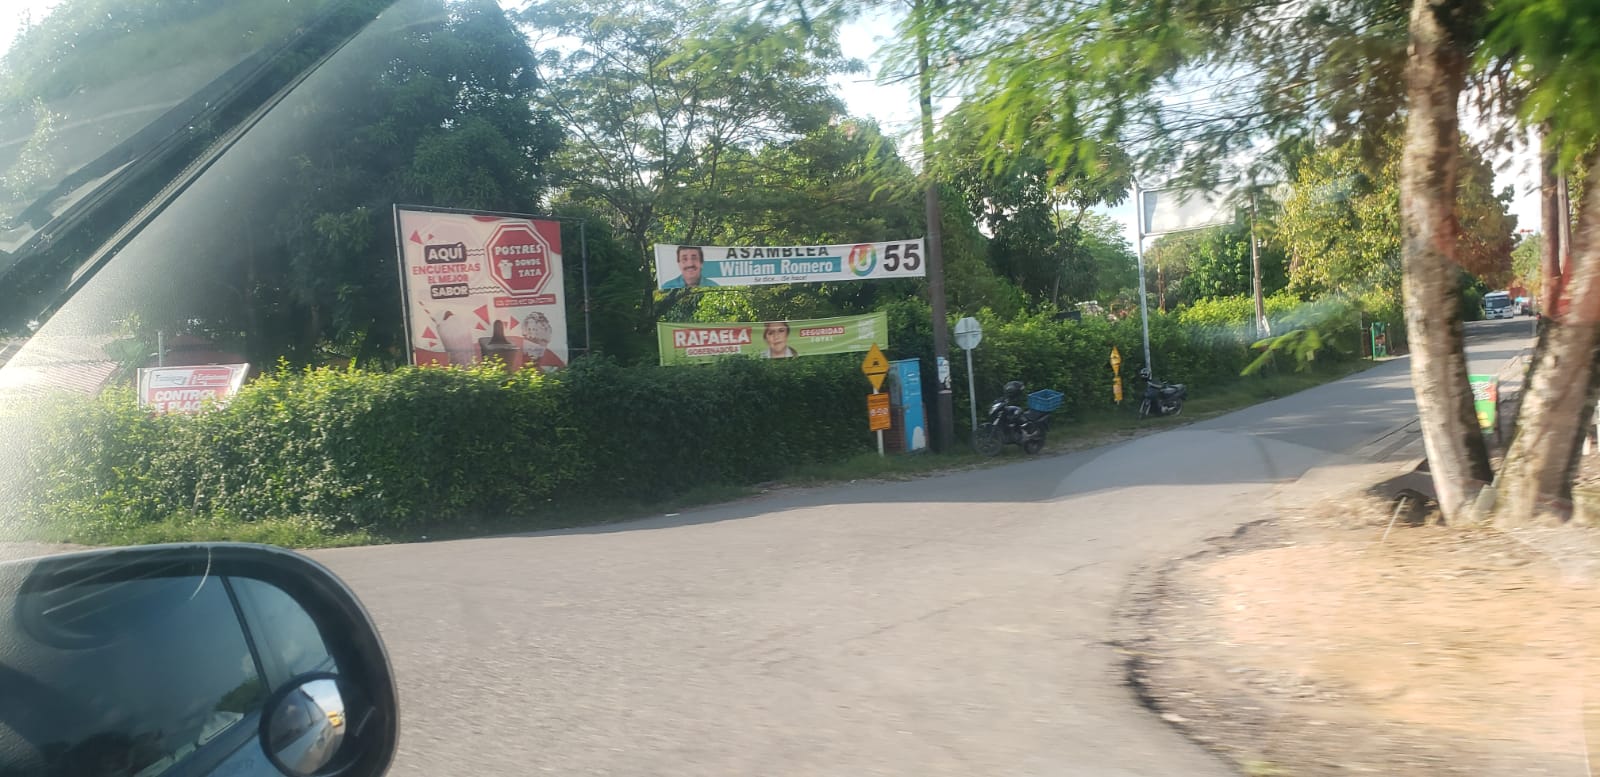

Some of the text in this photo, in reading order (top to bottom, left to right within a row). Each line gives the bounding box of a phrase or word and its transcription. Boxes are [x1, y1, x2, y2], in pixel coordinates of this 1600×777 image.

[428, 243, 463, 261] AQUÍ
[495, 244, 542, 256] POSTRES
[726, 246, 829, 259] ASAMBLEA
[883, 243, 921, 272] 55
[412, 263, 481, 275] ENCUENTRAS
[518, 268, 542, 278] TATA
[720, 259, 833, 276] William Romero
[432, 286, 469, 297] SABOR
[674, 328, 751, 347] RAFAELA
[800, 327, 844, 336] SEGURIDAD
